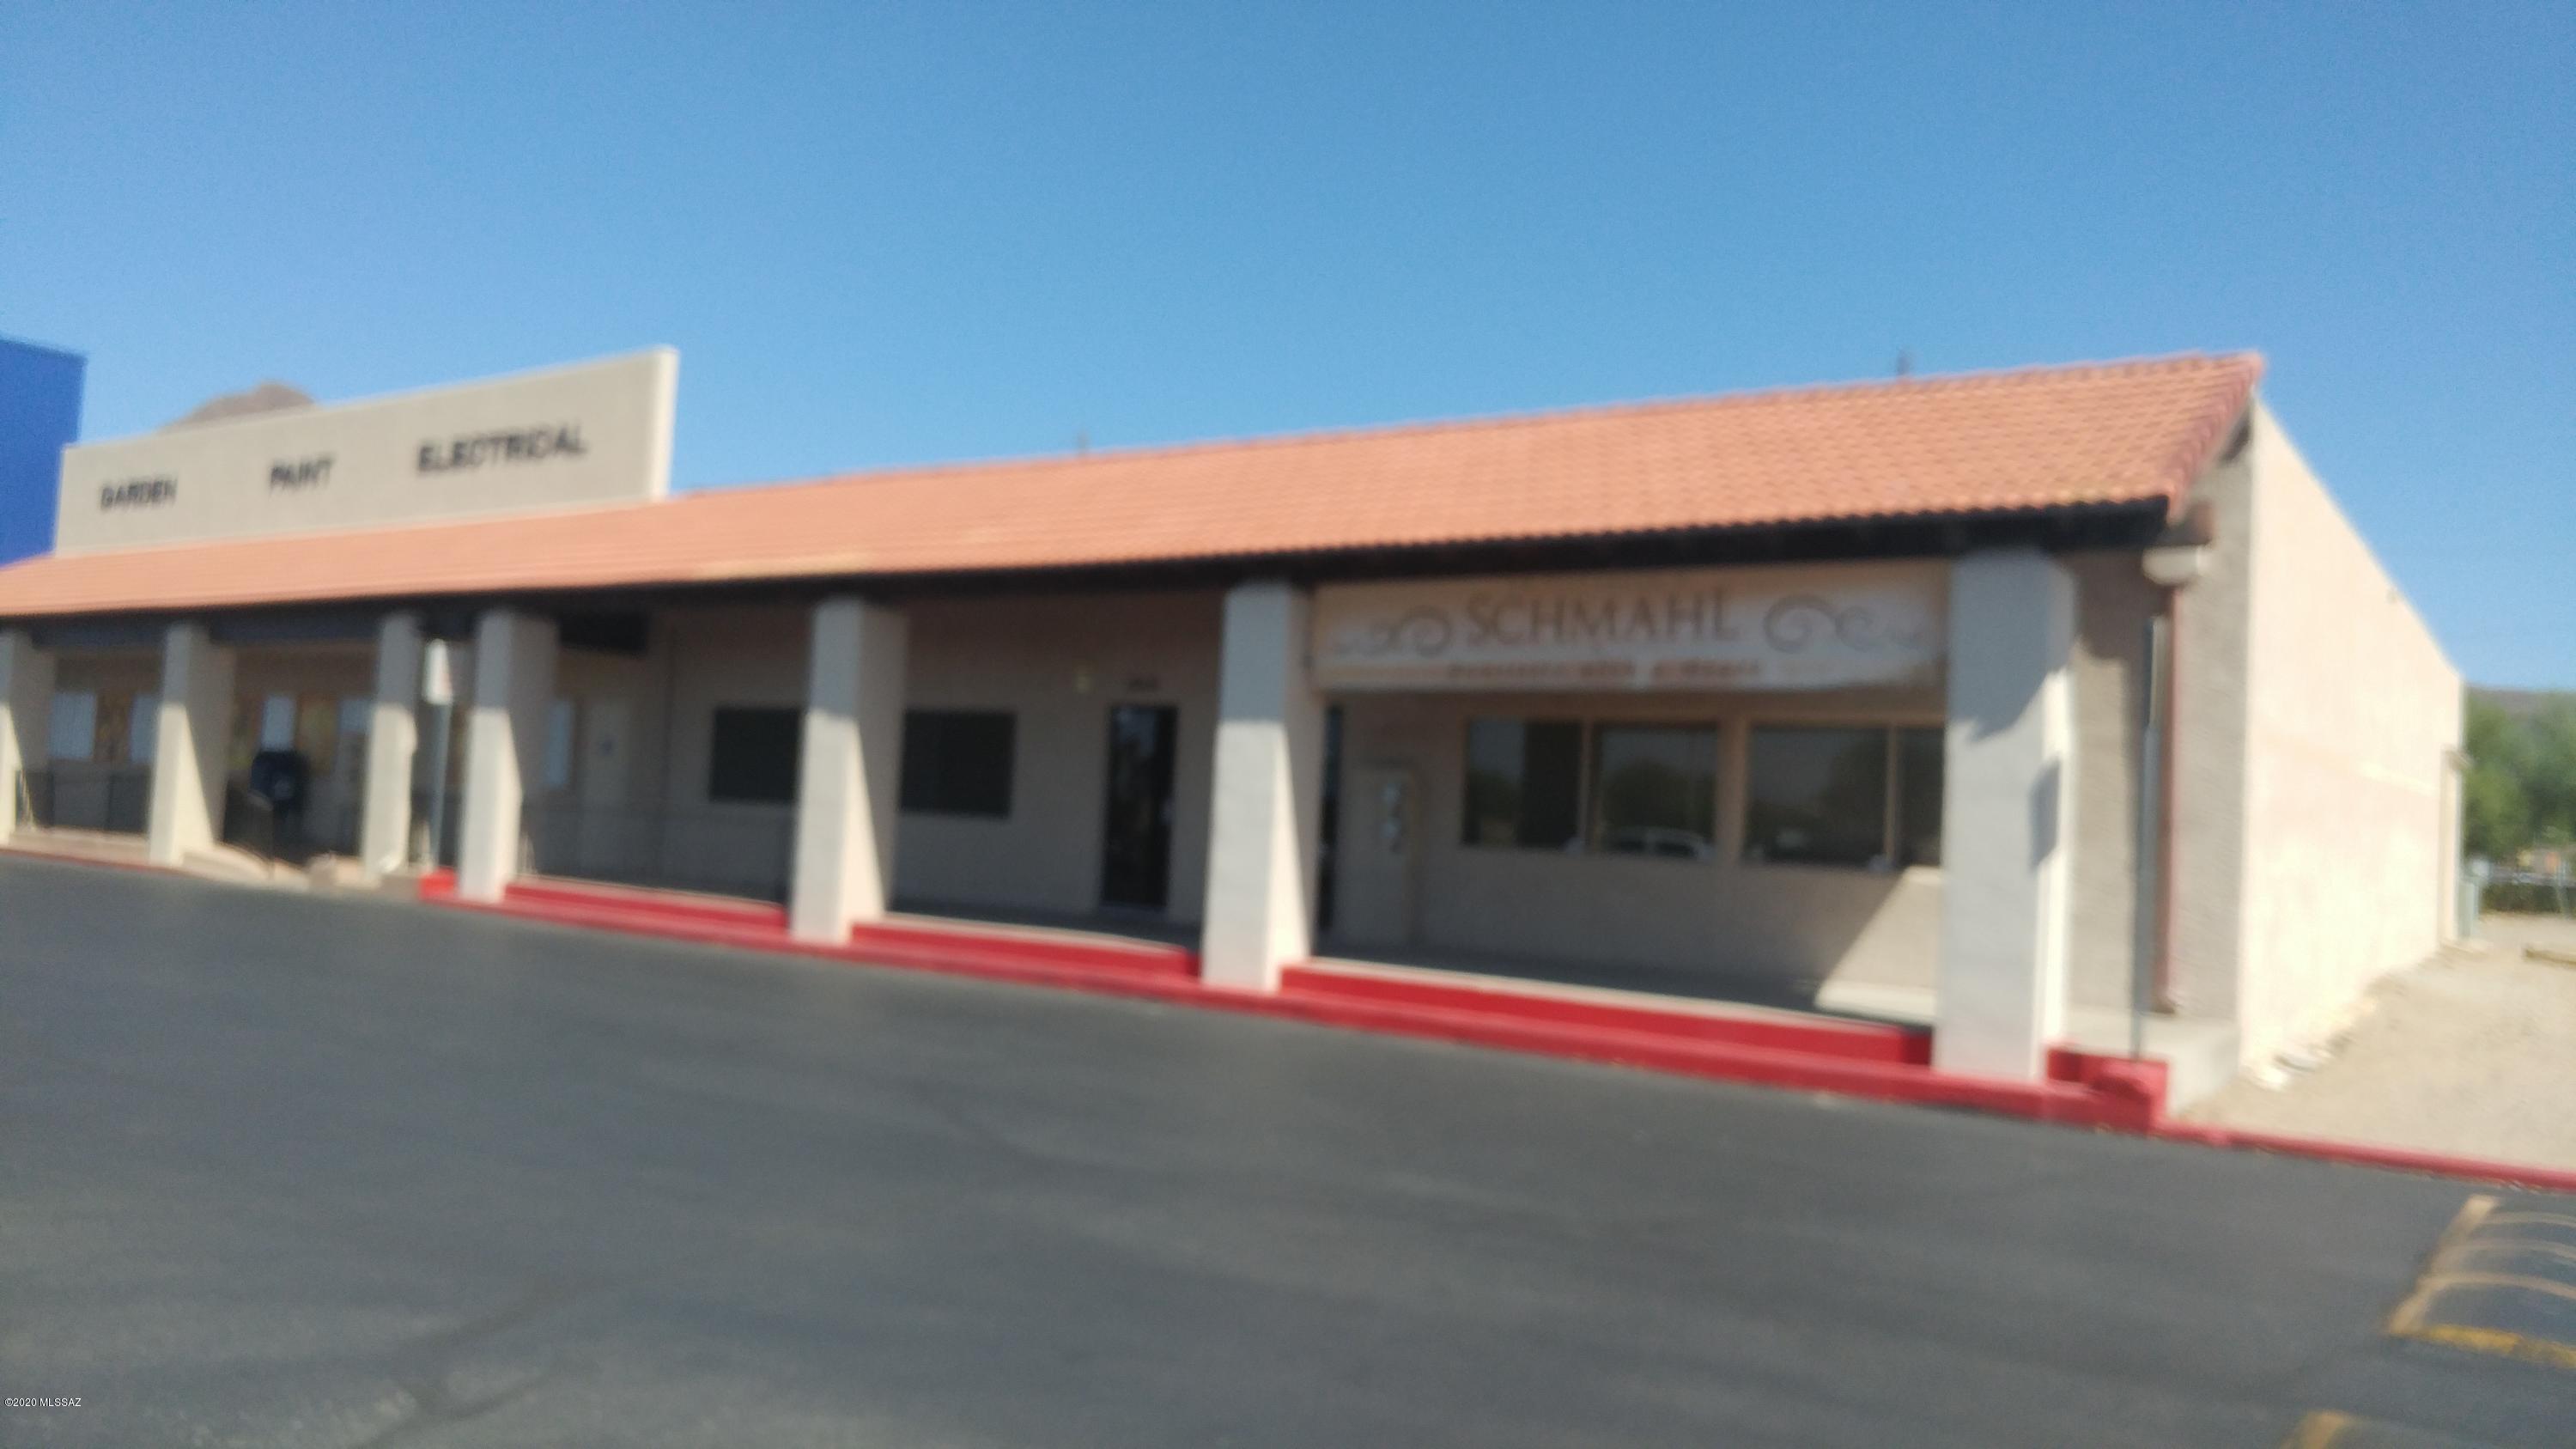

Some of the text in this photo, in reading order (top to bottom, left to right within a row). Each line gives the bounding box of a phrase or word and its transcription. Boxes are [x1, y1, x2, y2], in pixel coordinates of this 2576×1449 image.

[99, 422, 588, 512] GARDEN PAINT ELECTRICAL
[1465, 588, 1741, 646] SCHMAHL
